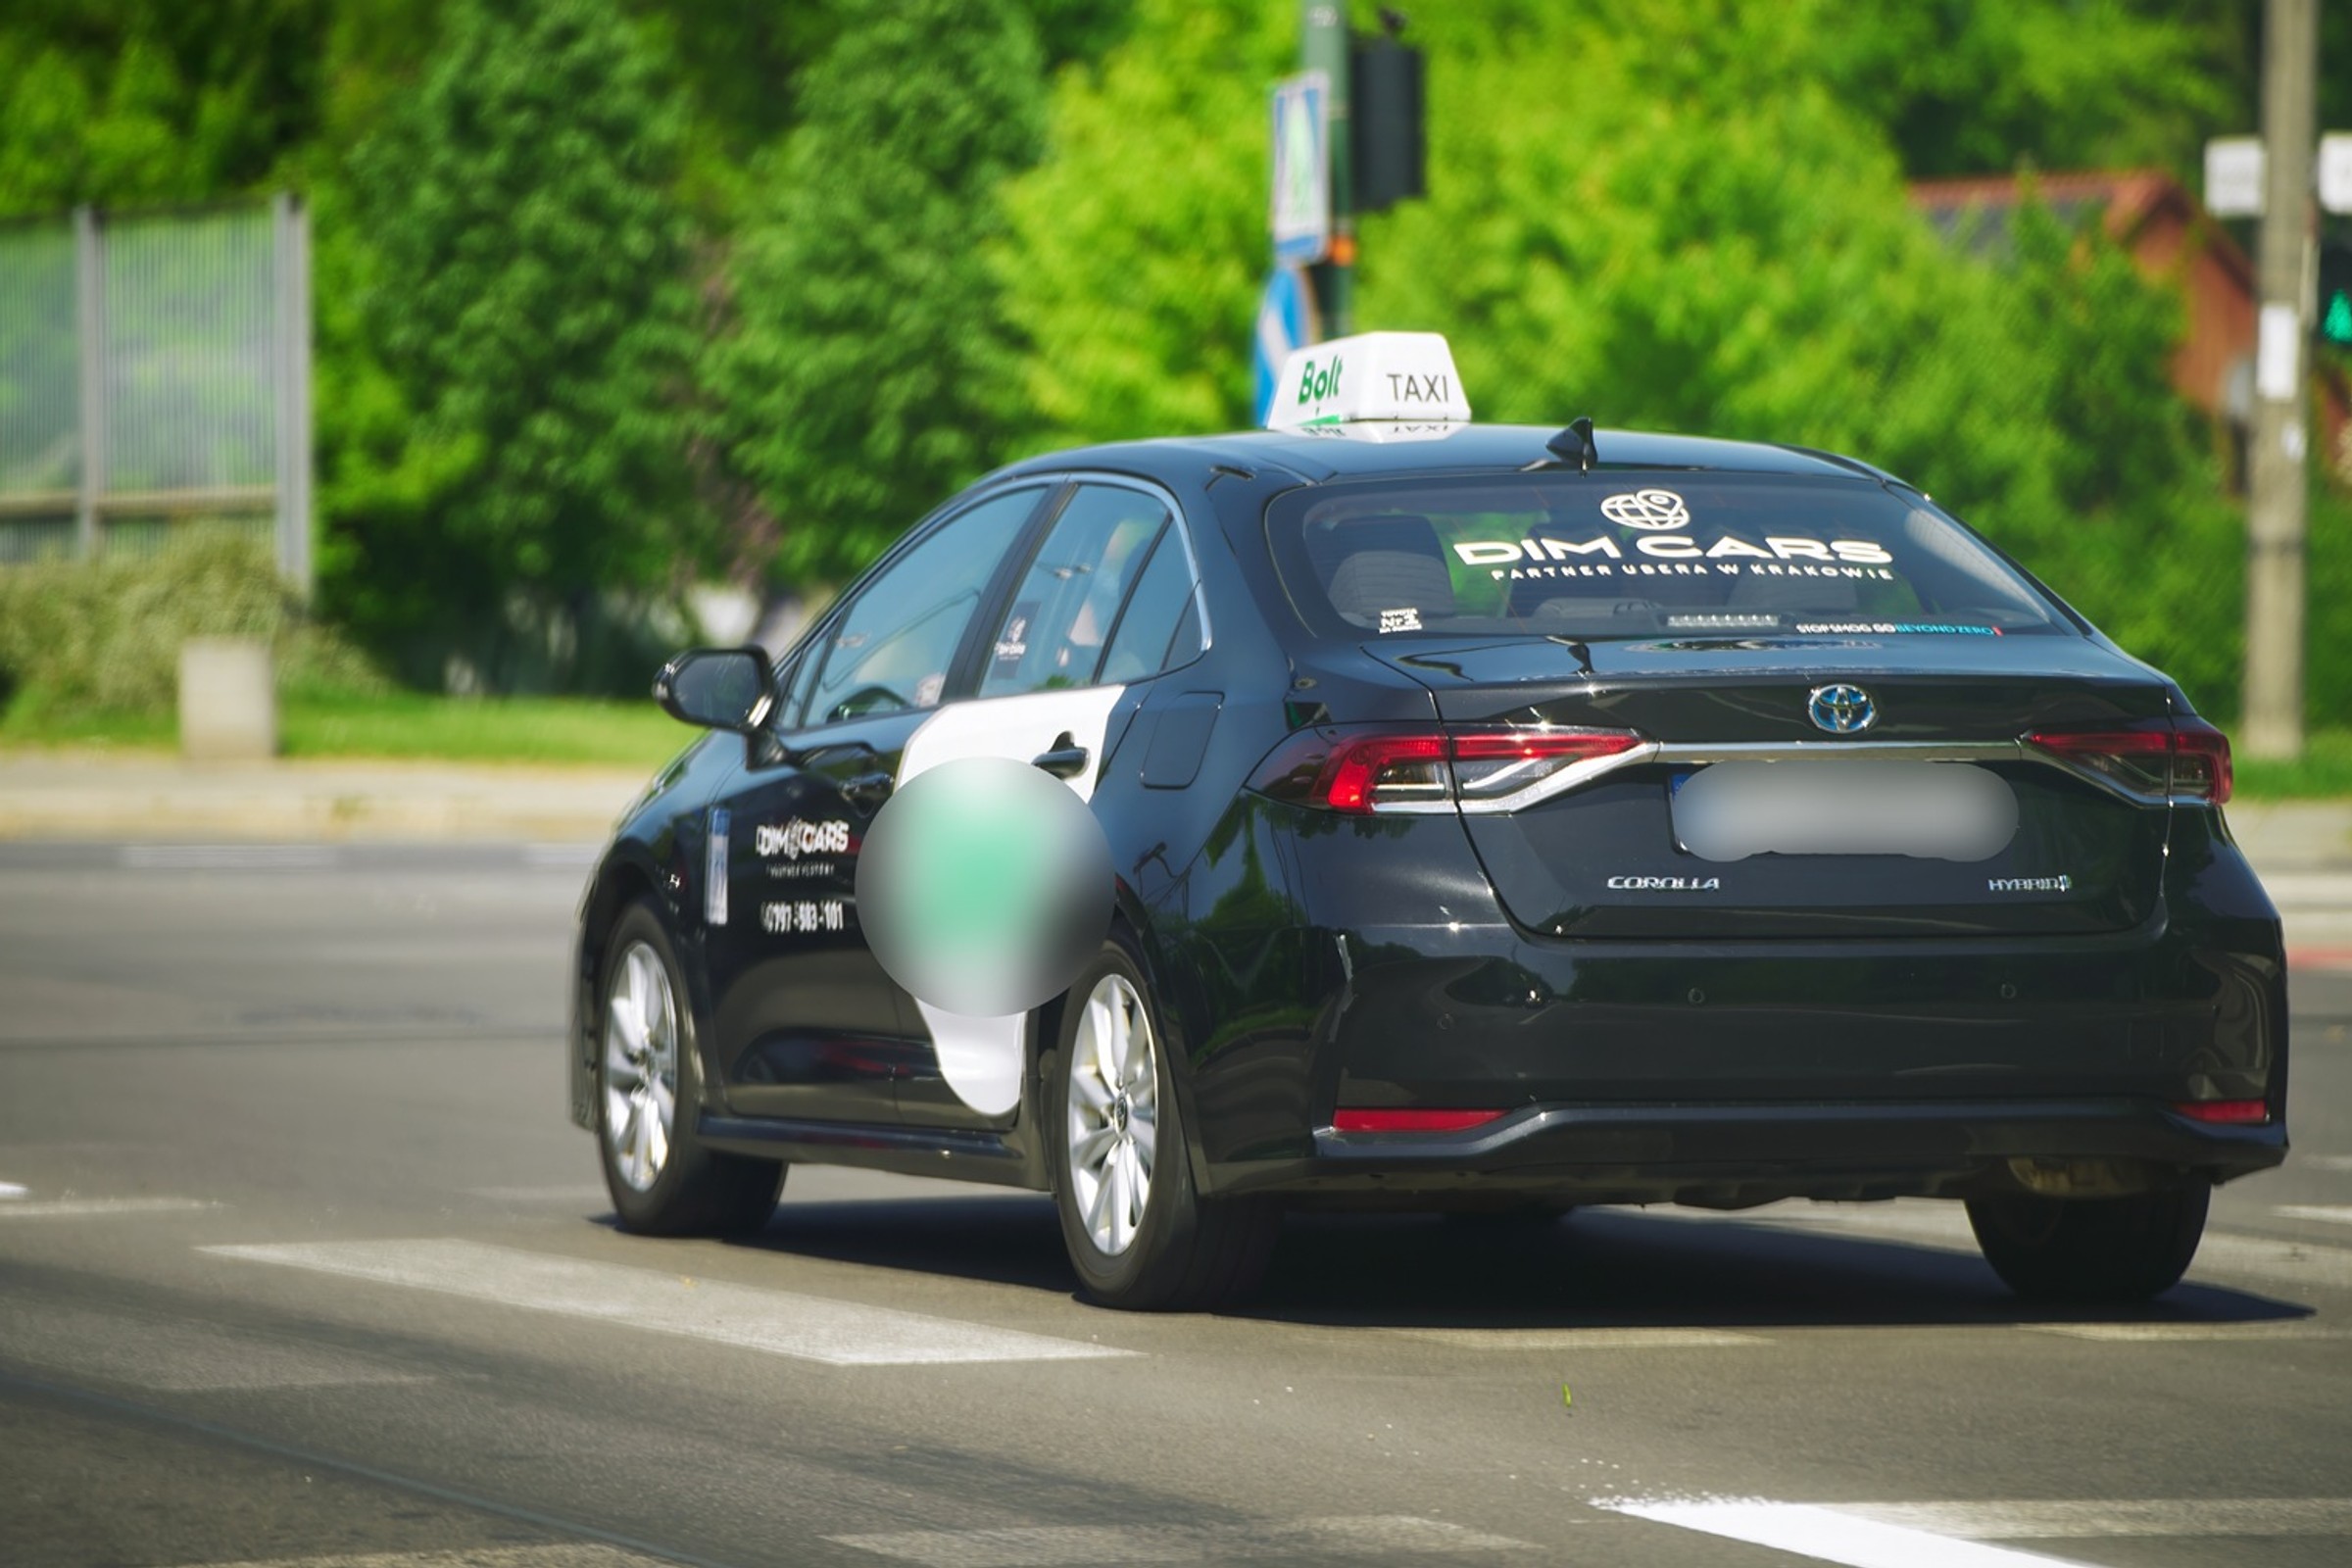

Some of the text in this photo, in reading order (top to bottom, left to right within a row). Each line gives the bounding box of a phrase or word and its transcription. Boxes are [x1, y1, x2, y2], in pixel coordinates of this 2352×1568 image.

[1298, 354, 1343, 406] Bolt
[1387, 373, 1449, 403] TAXI
[1453, 536, 1893, 565] DIM CARS
[1491, 564, 1894, 581] PARTNER UBERA W KRAKOWIE
[757, 820, 850, 857] DIM CARS
[1607, 876, 1720, 890] COROLLA
[1987, 877, 2059, 891] HYBRID
